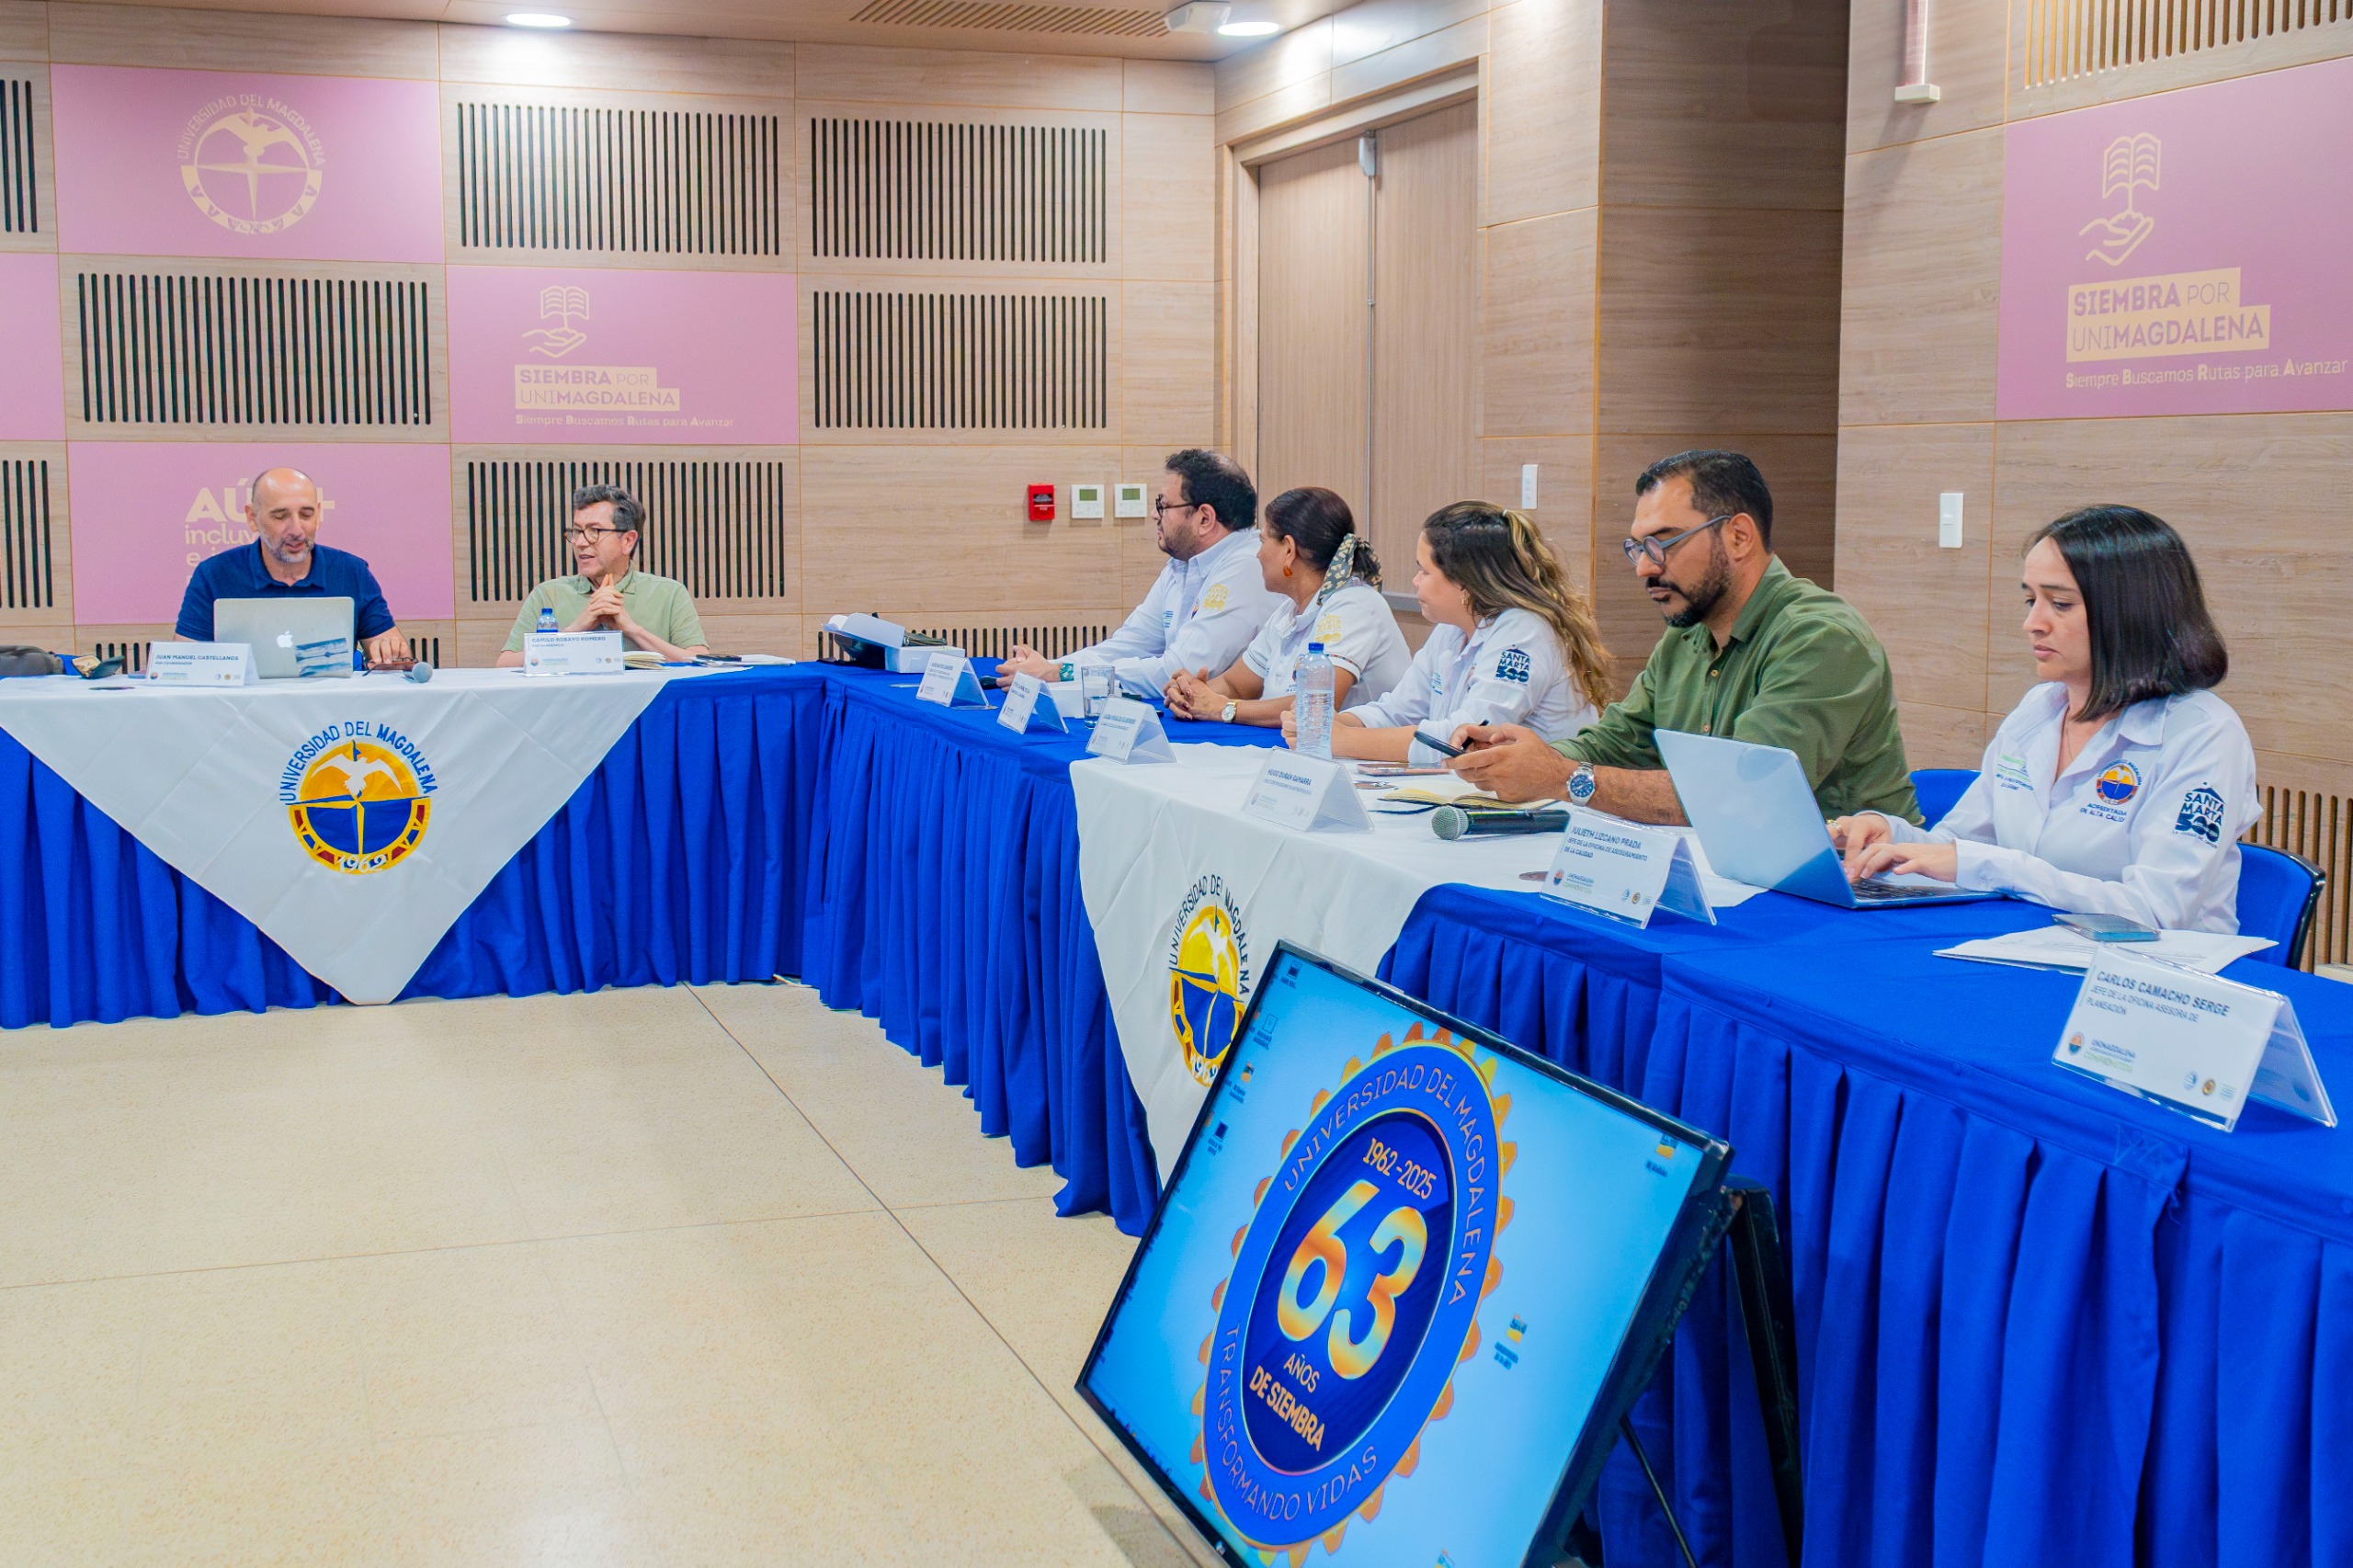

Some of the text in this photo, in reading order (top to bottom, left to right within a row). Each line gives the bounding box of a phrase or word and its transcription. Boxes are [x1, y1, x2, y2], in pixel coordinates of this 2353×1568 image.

[177, 94, 326, 166] UNIVERSIDAD DEL MAGDALENA
[2074, 281, 2230, 317] SIEMBRA POR
[2073, 312, 2264, 352] UNIMAGDALENA
[519, 369, 649, 385] SIEMBRA POR
[2066, 358, 2348, 391] Siempre Buscamos Rutas para Avanzar
[520, 390, 676, 405] UNIMAGDALENA
[516, 415, 734, 427] Siempre Buscamos Rutas para Avanzar
[1495, 665, 1529, 682] 500
[1499, 658, 1529, 672] MARTA
[1501, 651, 1530, 665] SANTA
[279, 721, 438, 801] UNIVERSIDAD DEL MAGDALENA
[2180, 802, 2222, 826] MARTA
[2184, 792, 2224, 815] SANTA
[1571, 826, 1642, 850] JULIETH LIZCANO PRADA
[2175, 812, 2220, 843] 500
[336, 854, 387, 873] 1962
[1169, 875, 1208, 965] UNIVERSIDAD
[1224, 885, 1250, 995] MAGDALENA
[2097, 971, 2231, 1017] CARLOS CAMACHO SERGE
[1285, 1064, 1485, 1305] UNIVERSIDAD DEL MAGDALENA
[1277, 1179, 1427, 1380] 63
[1283, 1352, 1320, 1393] AÑOS
[1217, 1323, 1377, 1521] TRANSFORMANDO VIDAS
[1249, 1365, 1325, 1452] DE SIEMBRA
